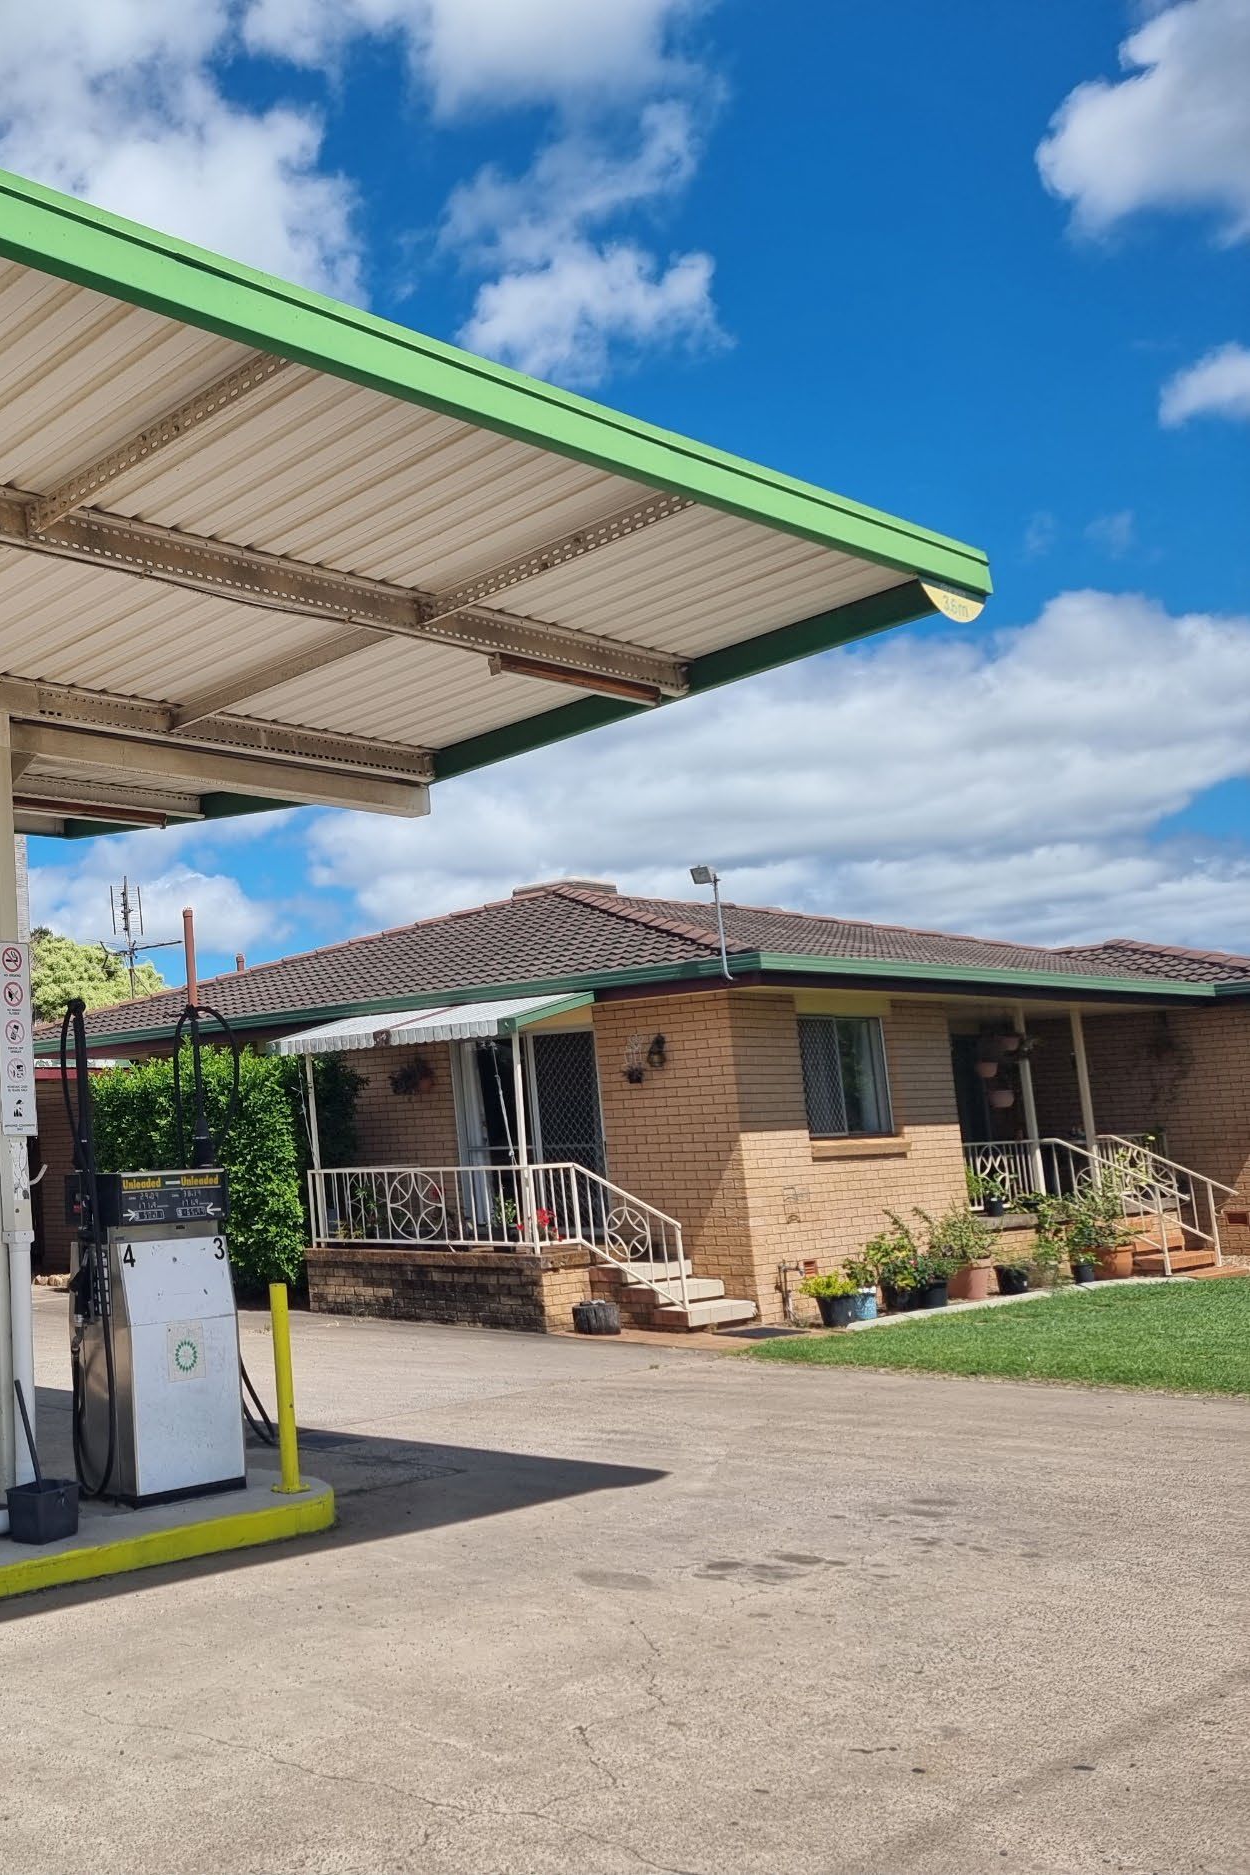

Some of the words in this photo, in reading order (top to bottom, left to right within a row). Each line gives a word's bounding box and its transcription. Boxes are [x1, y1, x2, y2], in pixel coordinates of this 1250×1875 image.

[122, 1176, 162, 1190] Unleaded
[180, 1173, 219, 1186] Unleaded
[122, 1243, 136, 1268] 4
[213, 1237, 225, 1260] 3
